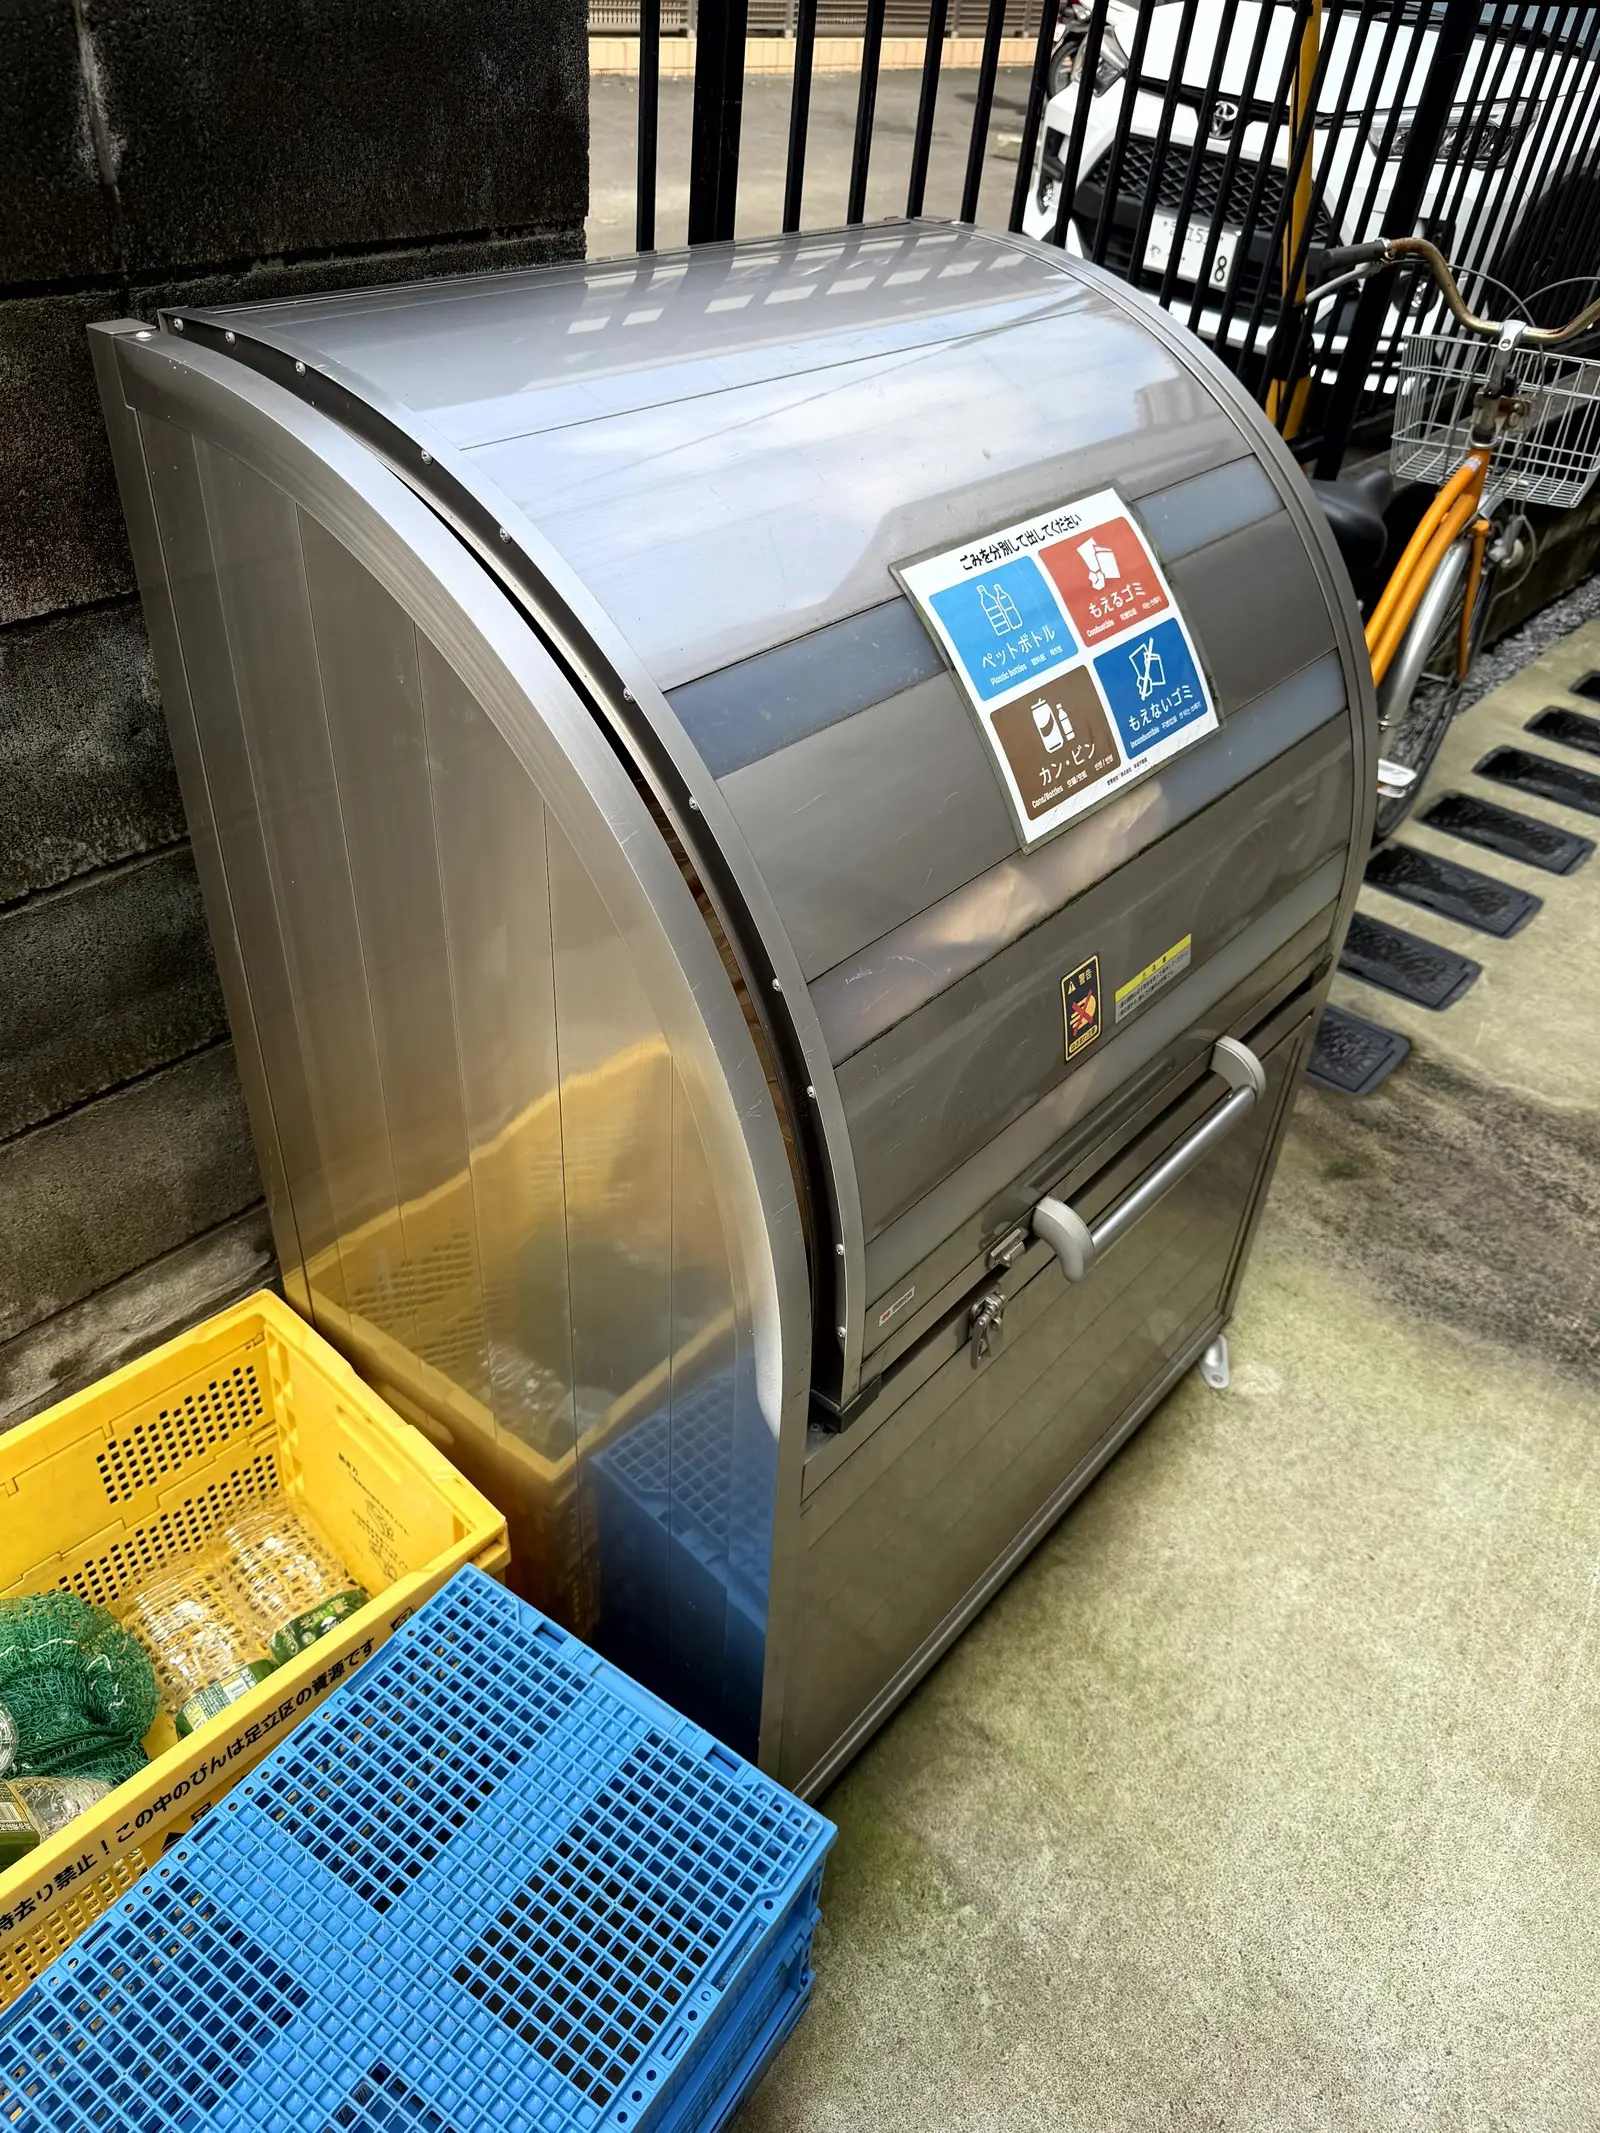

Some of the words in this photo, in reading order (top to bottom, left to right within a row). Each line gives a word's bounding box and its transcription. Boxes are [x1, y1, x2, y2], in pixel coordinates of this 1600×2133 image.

[959, 514, 1082, 571] ごみを分別して出してください
[1088, 582, 1146, 618] もえるゴミ
[982, 624, 1056, 668] ペットボトル
[990, 670, 1010, 686] Plastic
[1007, 663, 1028, 678] bottles
[1129, 685, 1194, 731] もえないゴミ
[1039, 743, 1095, 786] カン・ビン
